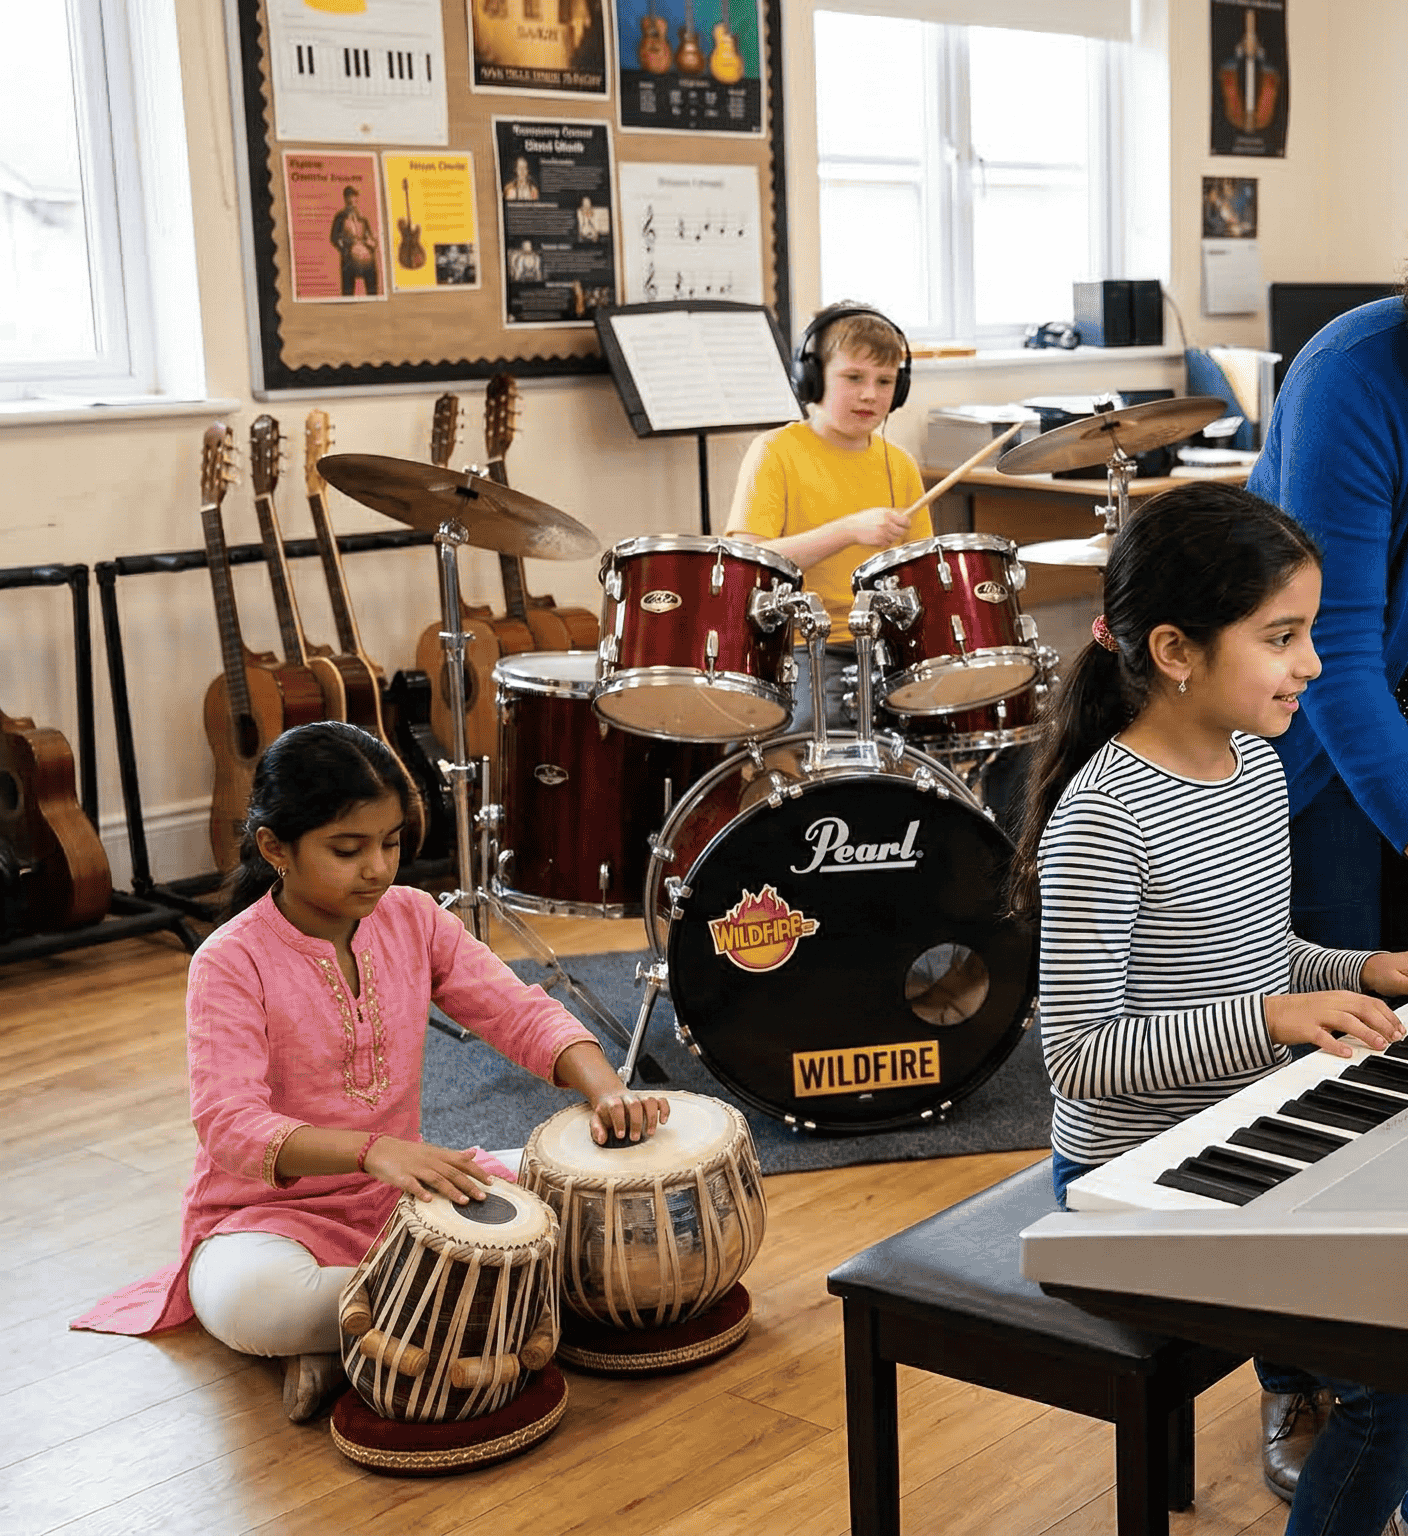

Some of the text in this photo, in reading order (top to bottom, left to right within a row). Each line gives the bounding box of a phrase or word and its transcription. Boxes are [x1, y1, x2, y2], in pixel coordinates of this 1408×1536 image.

[790, 816, 921, 875] Pearl
[714, 914, 804, 953] WILDFIRE
[799, 1046, 935, 1091] WILDFIRE
